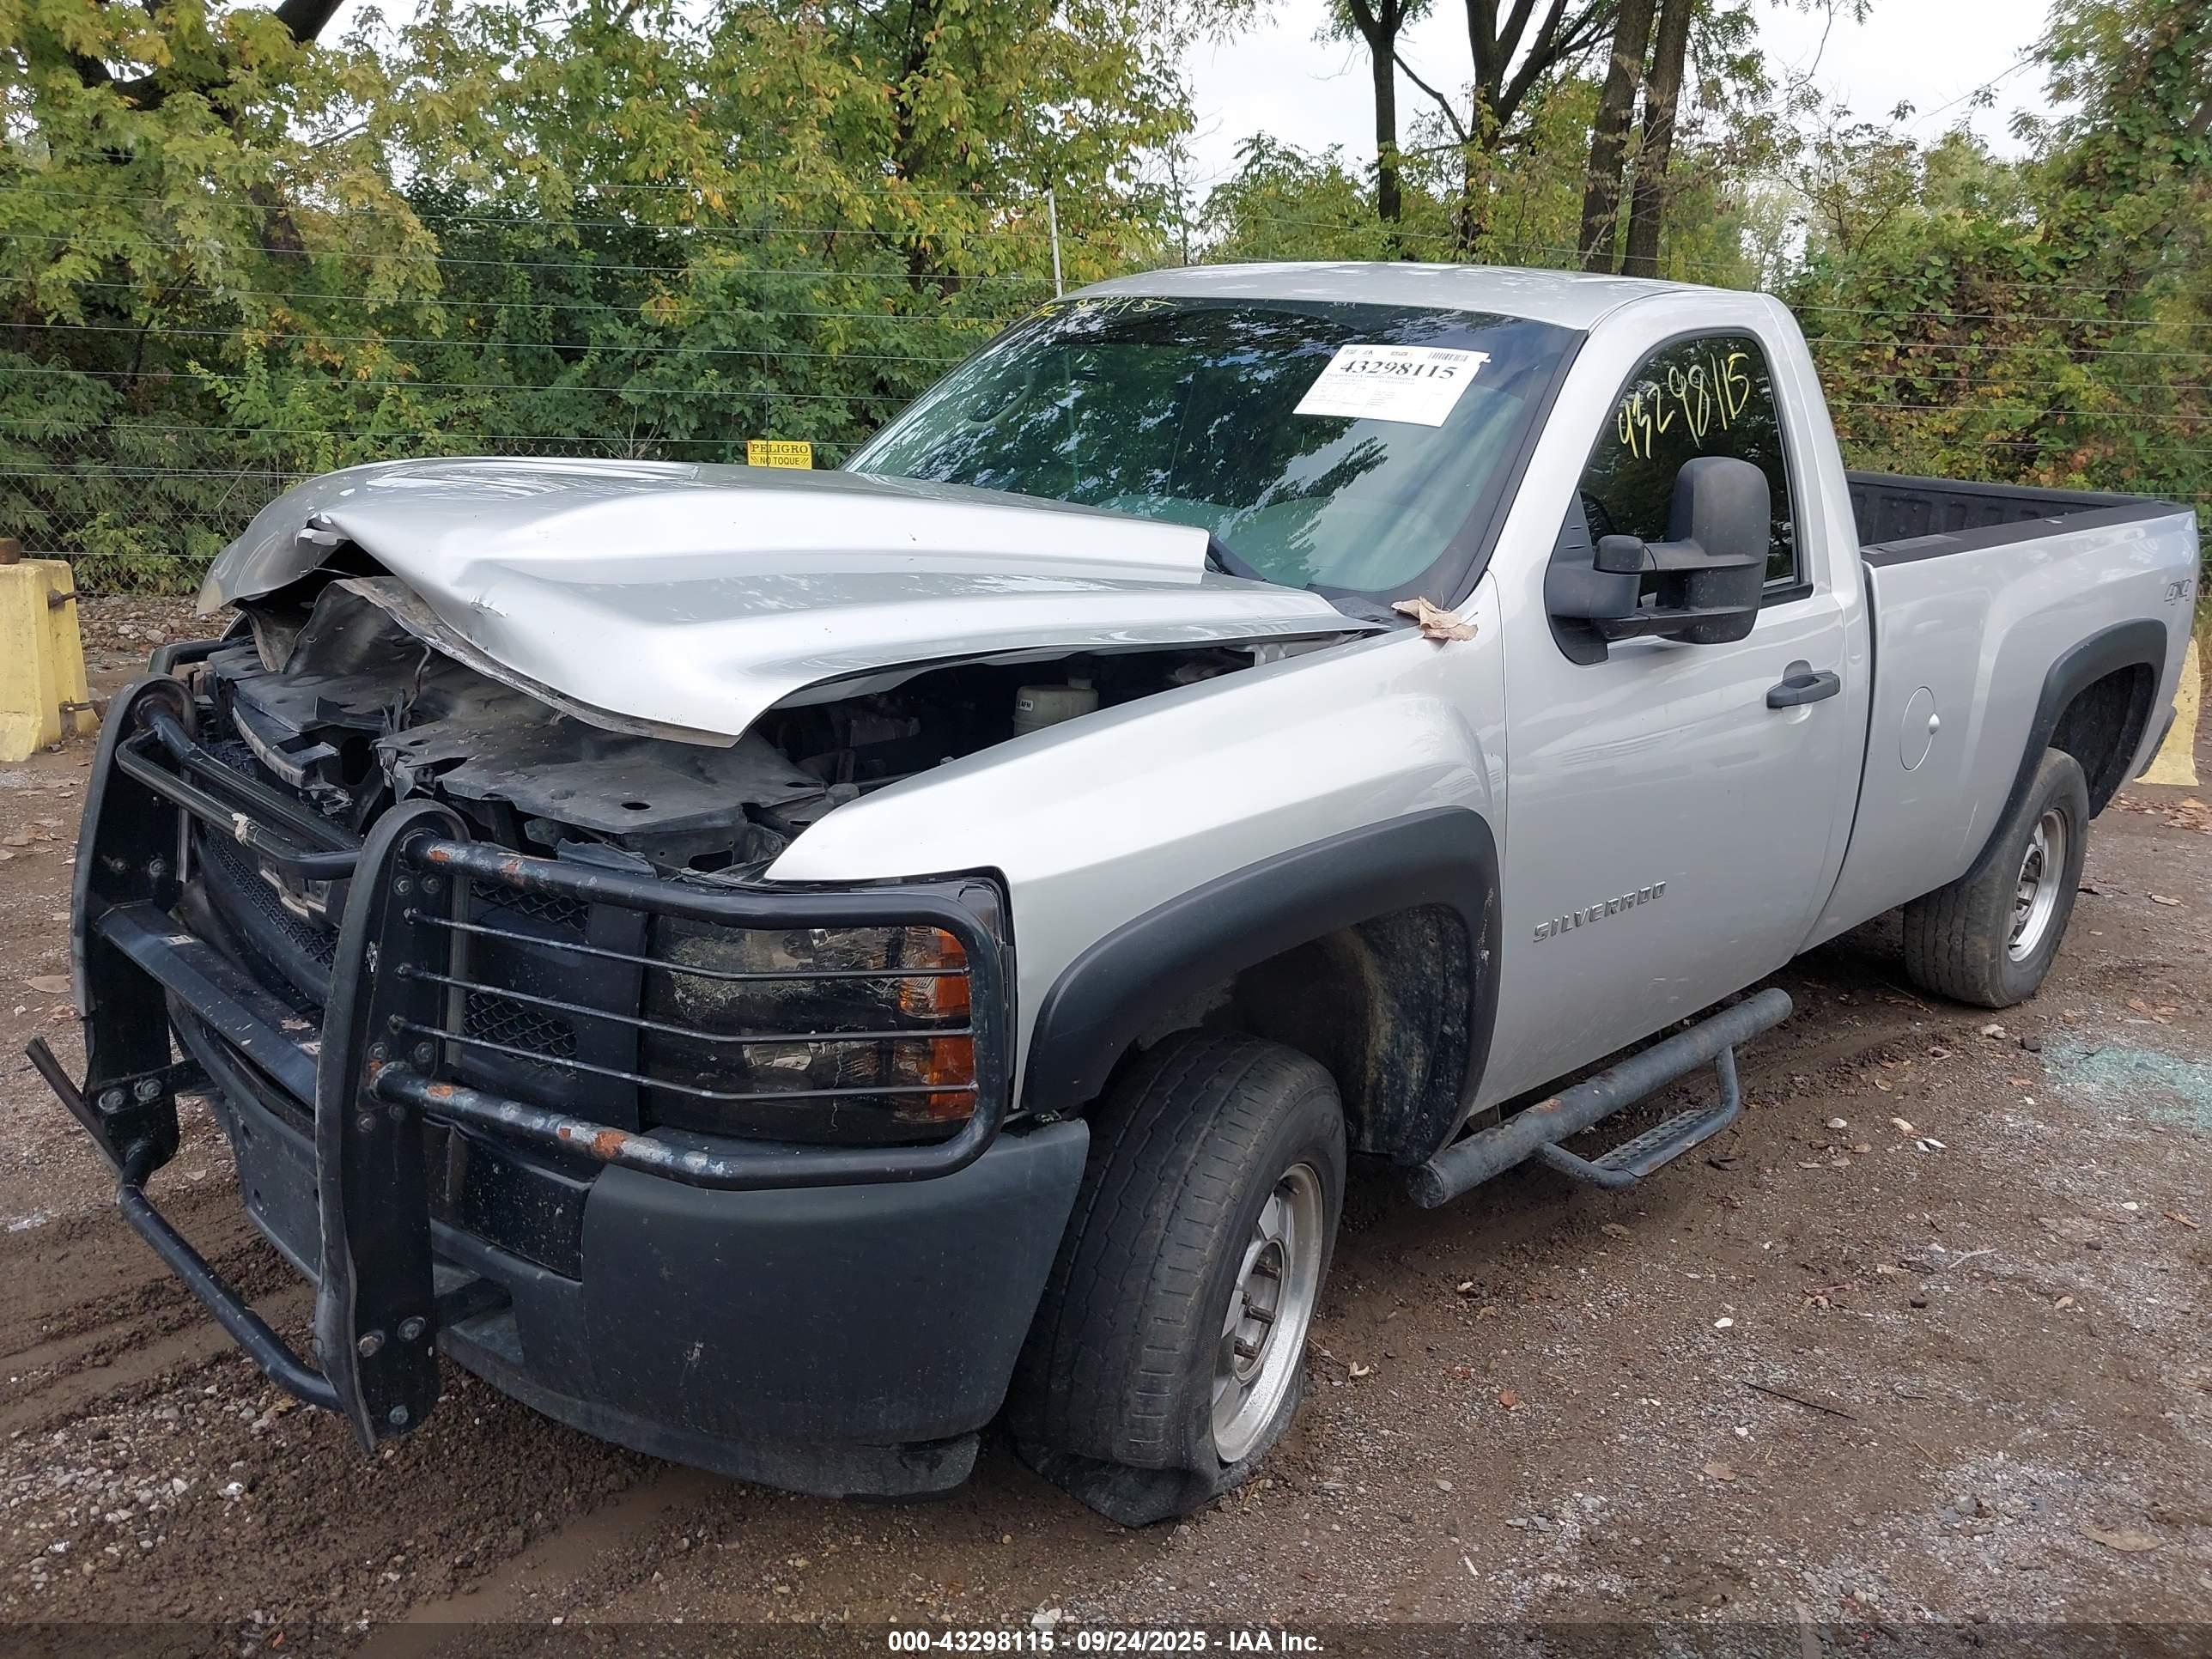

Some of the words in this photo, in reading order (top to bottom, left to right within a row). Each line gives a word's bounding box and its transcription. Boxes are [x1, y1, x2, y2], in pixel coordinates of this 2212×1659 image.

[1339, 359, 1459, 380] 43298115
[750, 443, 809, 453] PELIGRO
[760, 456, 772, 465] NO
[773, 456, 800, 465] TOQUE
[1533, 880, 1667, 943] SILVERADO
